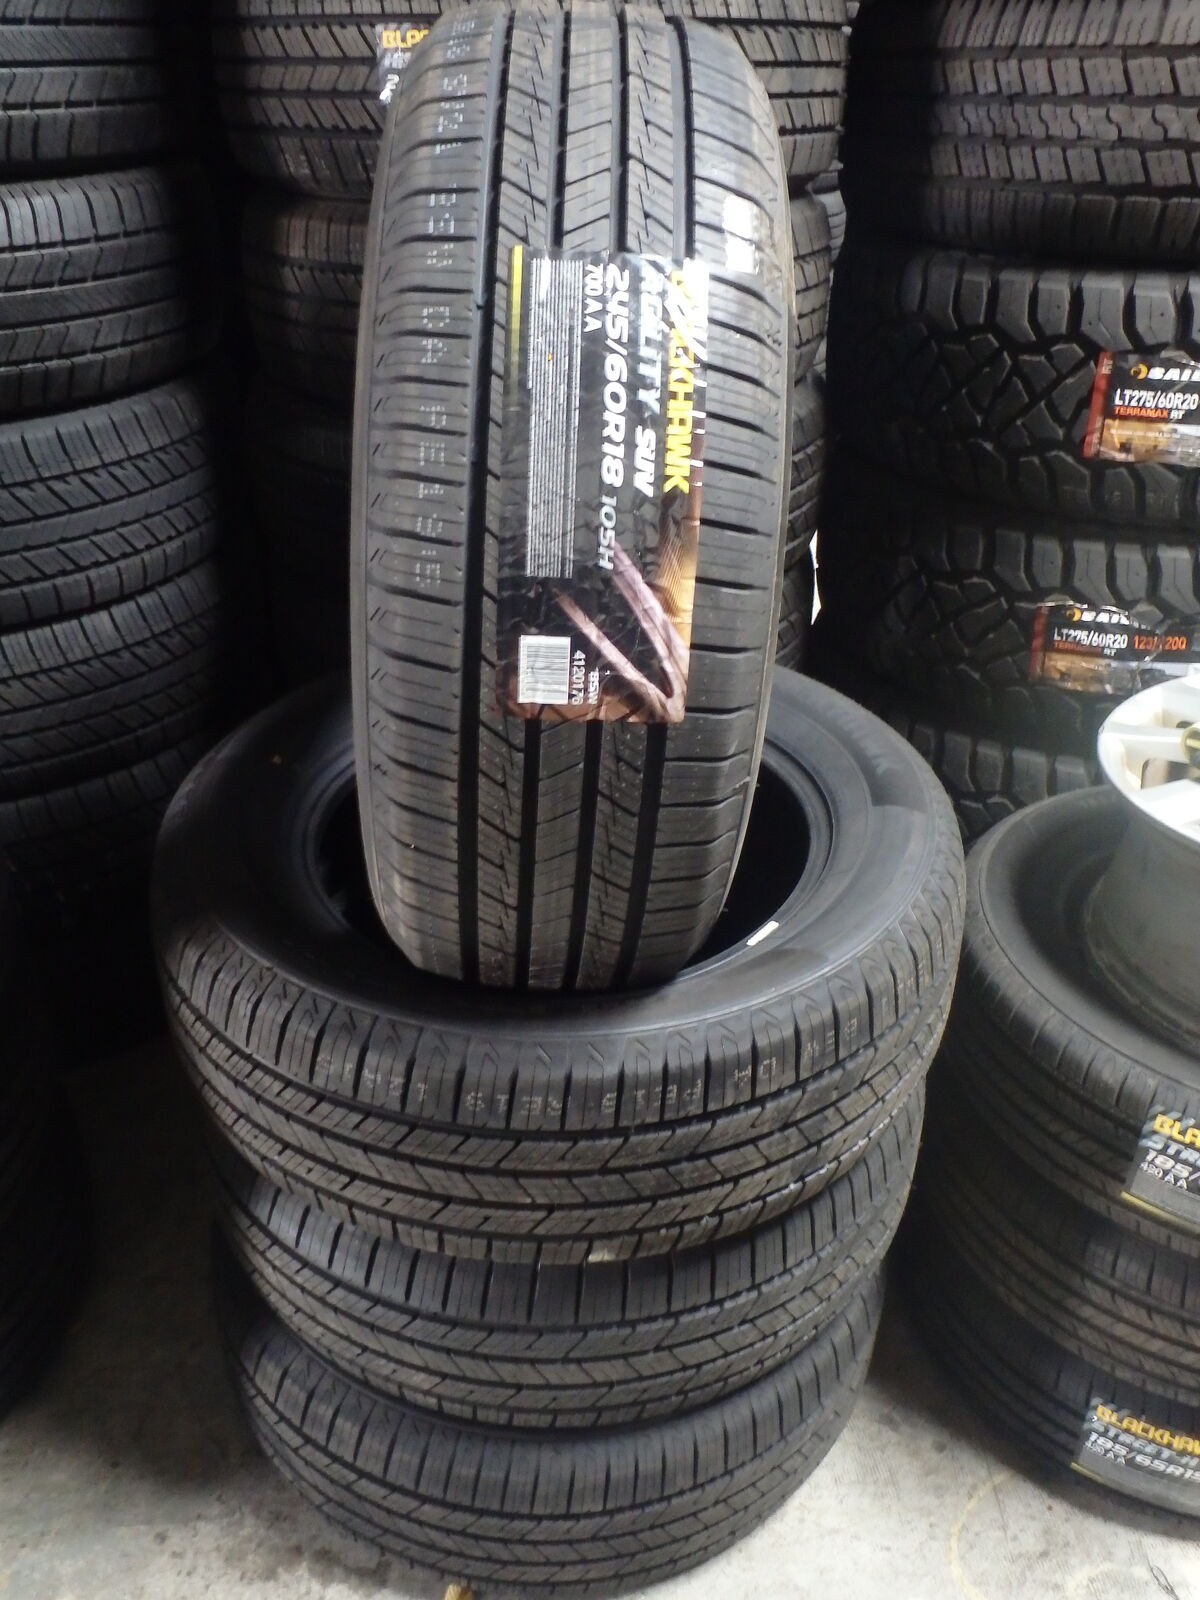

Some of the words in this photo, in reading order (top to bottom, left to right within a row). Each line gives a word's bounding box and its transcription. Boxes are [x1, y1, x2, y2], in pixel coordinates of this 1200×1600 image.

[636, 265, 664, 417] AGILITY
[601, 262, 630, 489] 245/60R18
[1114, 387, 1199, 410] LT275/60R20
[1114, 405, 1169, 418] TERRAMAX
[633, 425, 657, 498] SUV
[598, 495, 618, 570] 105H
[1053, 626, 1129, 649] LT275/60R20
[1139, 1132, 1200, 1168] STR
